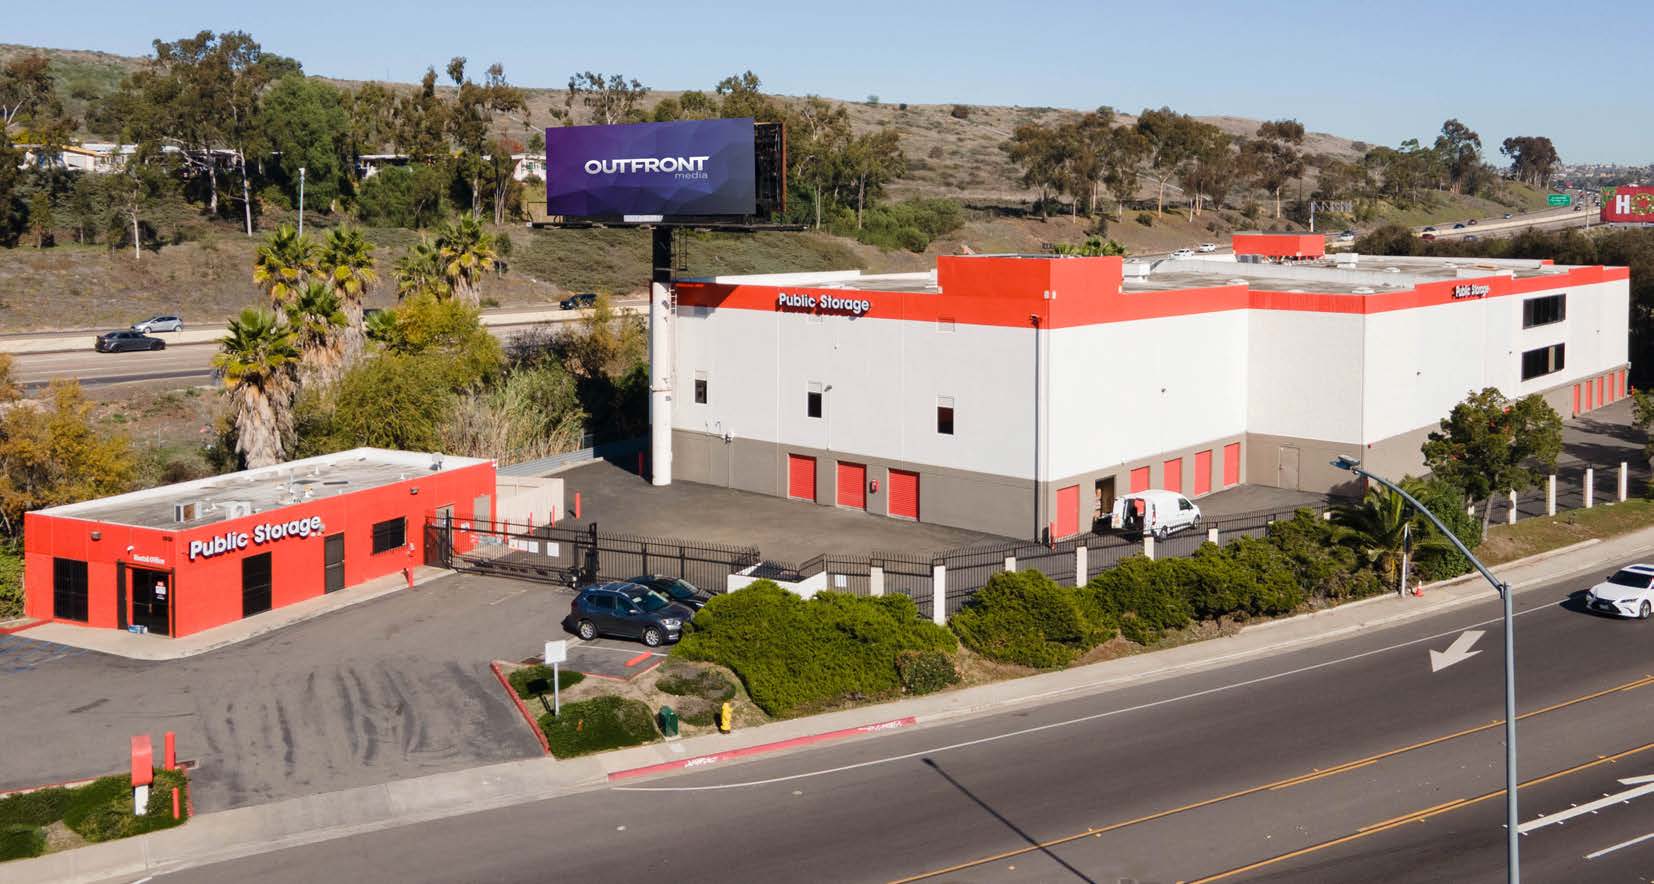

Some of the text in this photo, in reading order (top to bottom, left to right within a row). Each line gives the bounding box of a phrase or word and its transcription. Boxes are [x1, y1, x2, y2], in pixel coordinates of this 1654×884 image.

[584, 156, 710, 175] OUTFRONT
[675, 171, 709, 180] media
[779, 292, 870, 315] Public Storage
[189, 515, 321, 560] Public Storage
